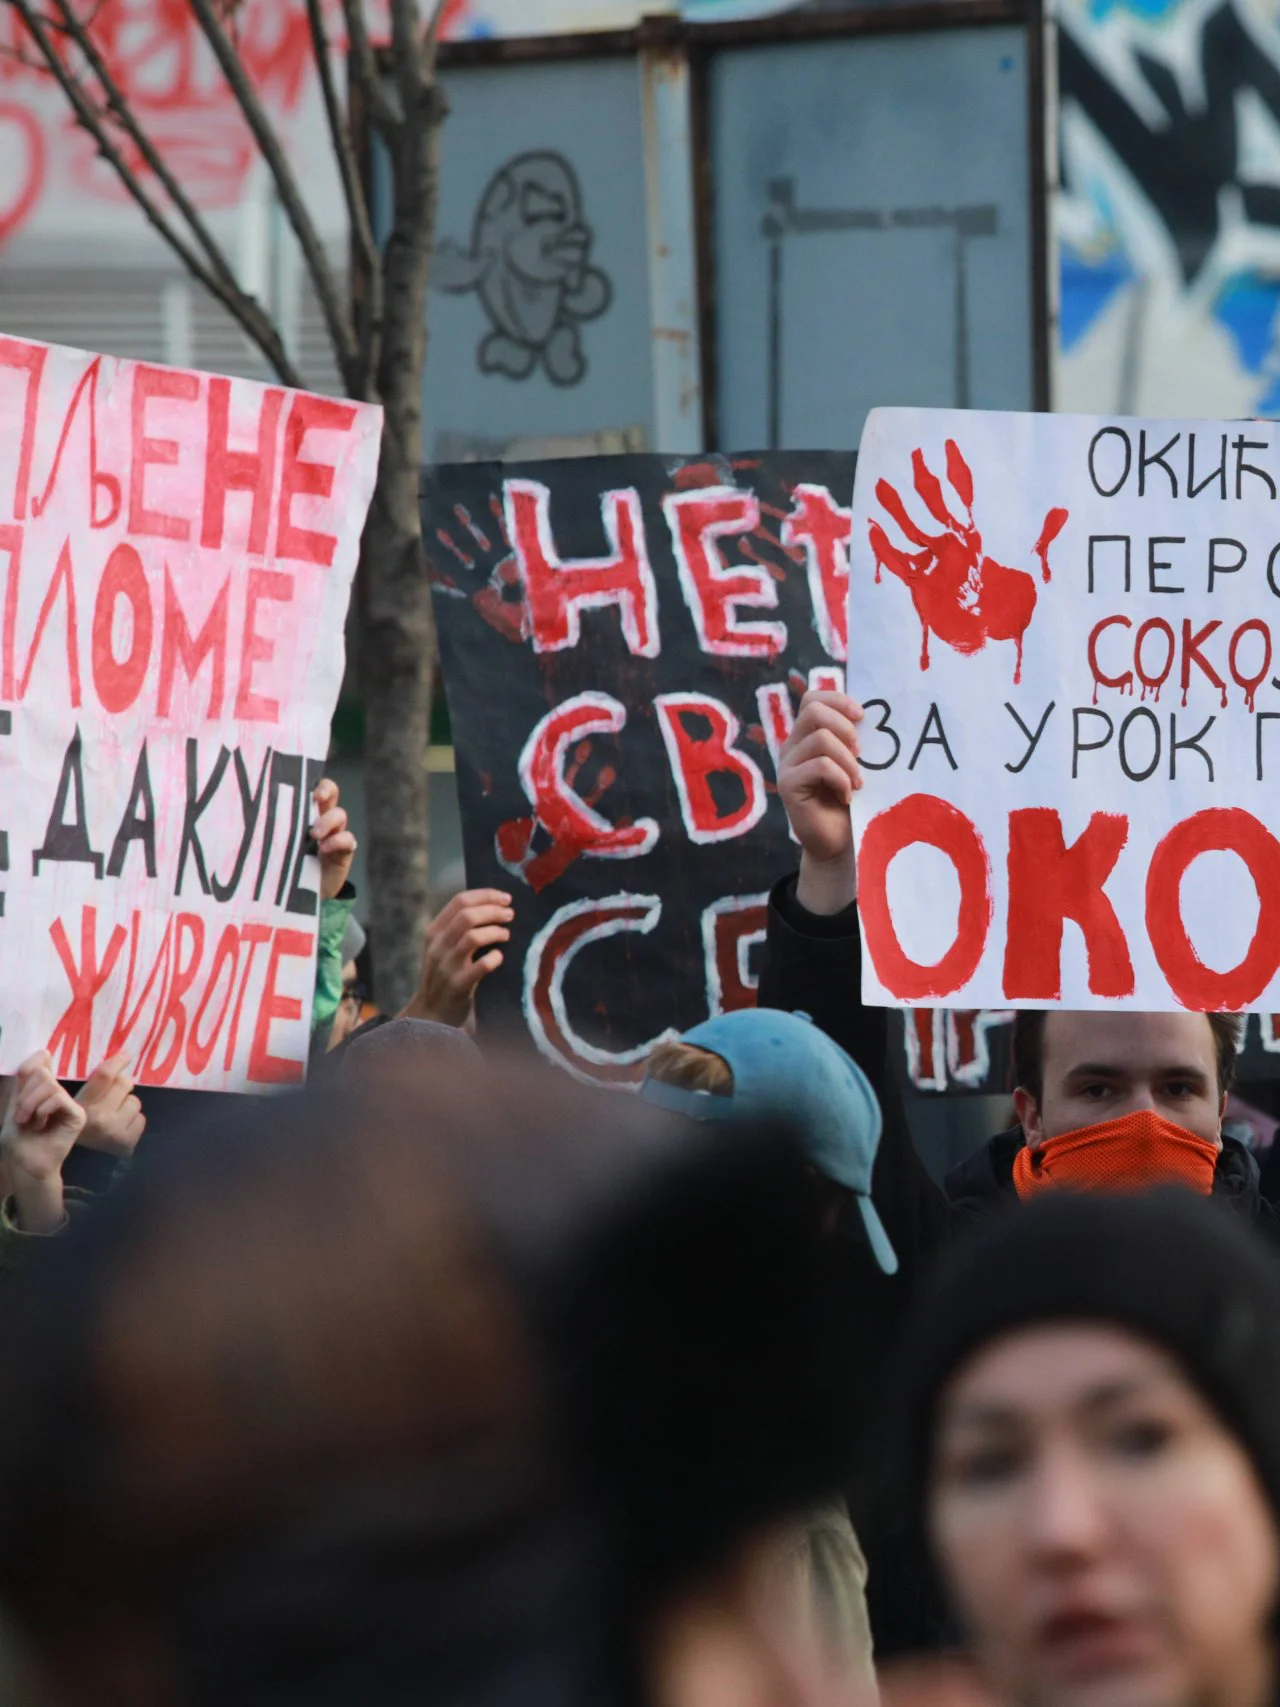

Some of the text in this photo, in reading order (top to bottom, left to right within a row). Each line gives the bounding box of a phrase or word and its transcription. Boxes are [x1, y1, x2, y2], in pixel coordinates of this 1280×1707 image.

[32, 722, 156, 880] ДА
[175, 736, 325, 916] КУПЕ
[856, 698, 959, 772] ЗА
[48, 904, 315, 1086] ЖИВОТЕ
